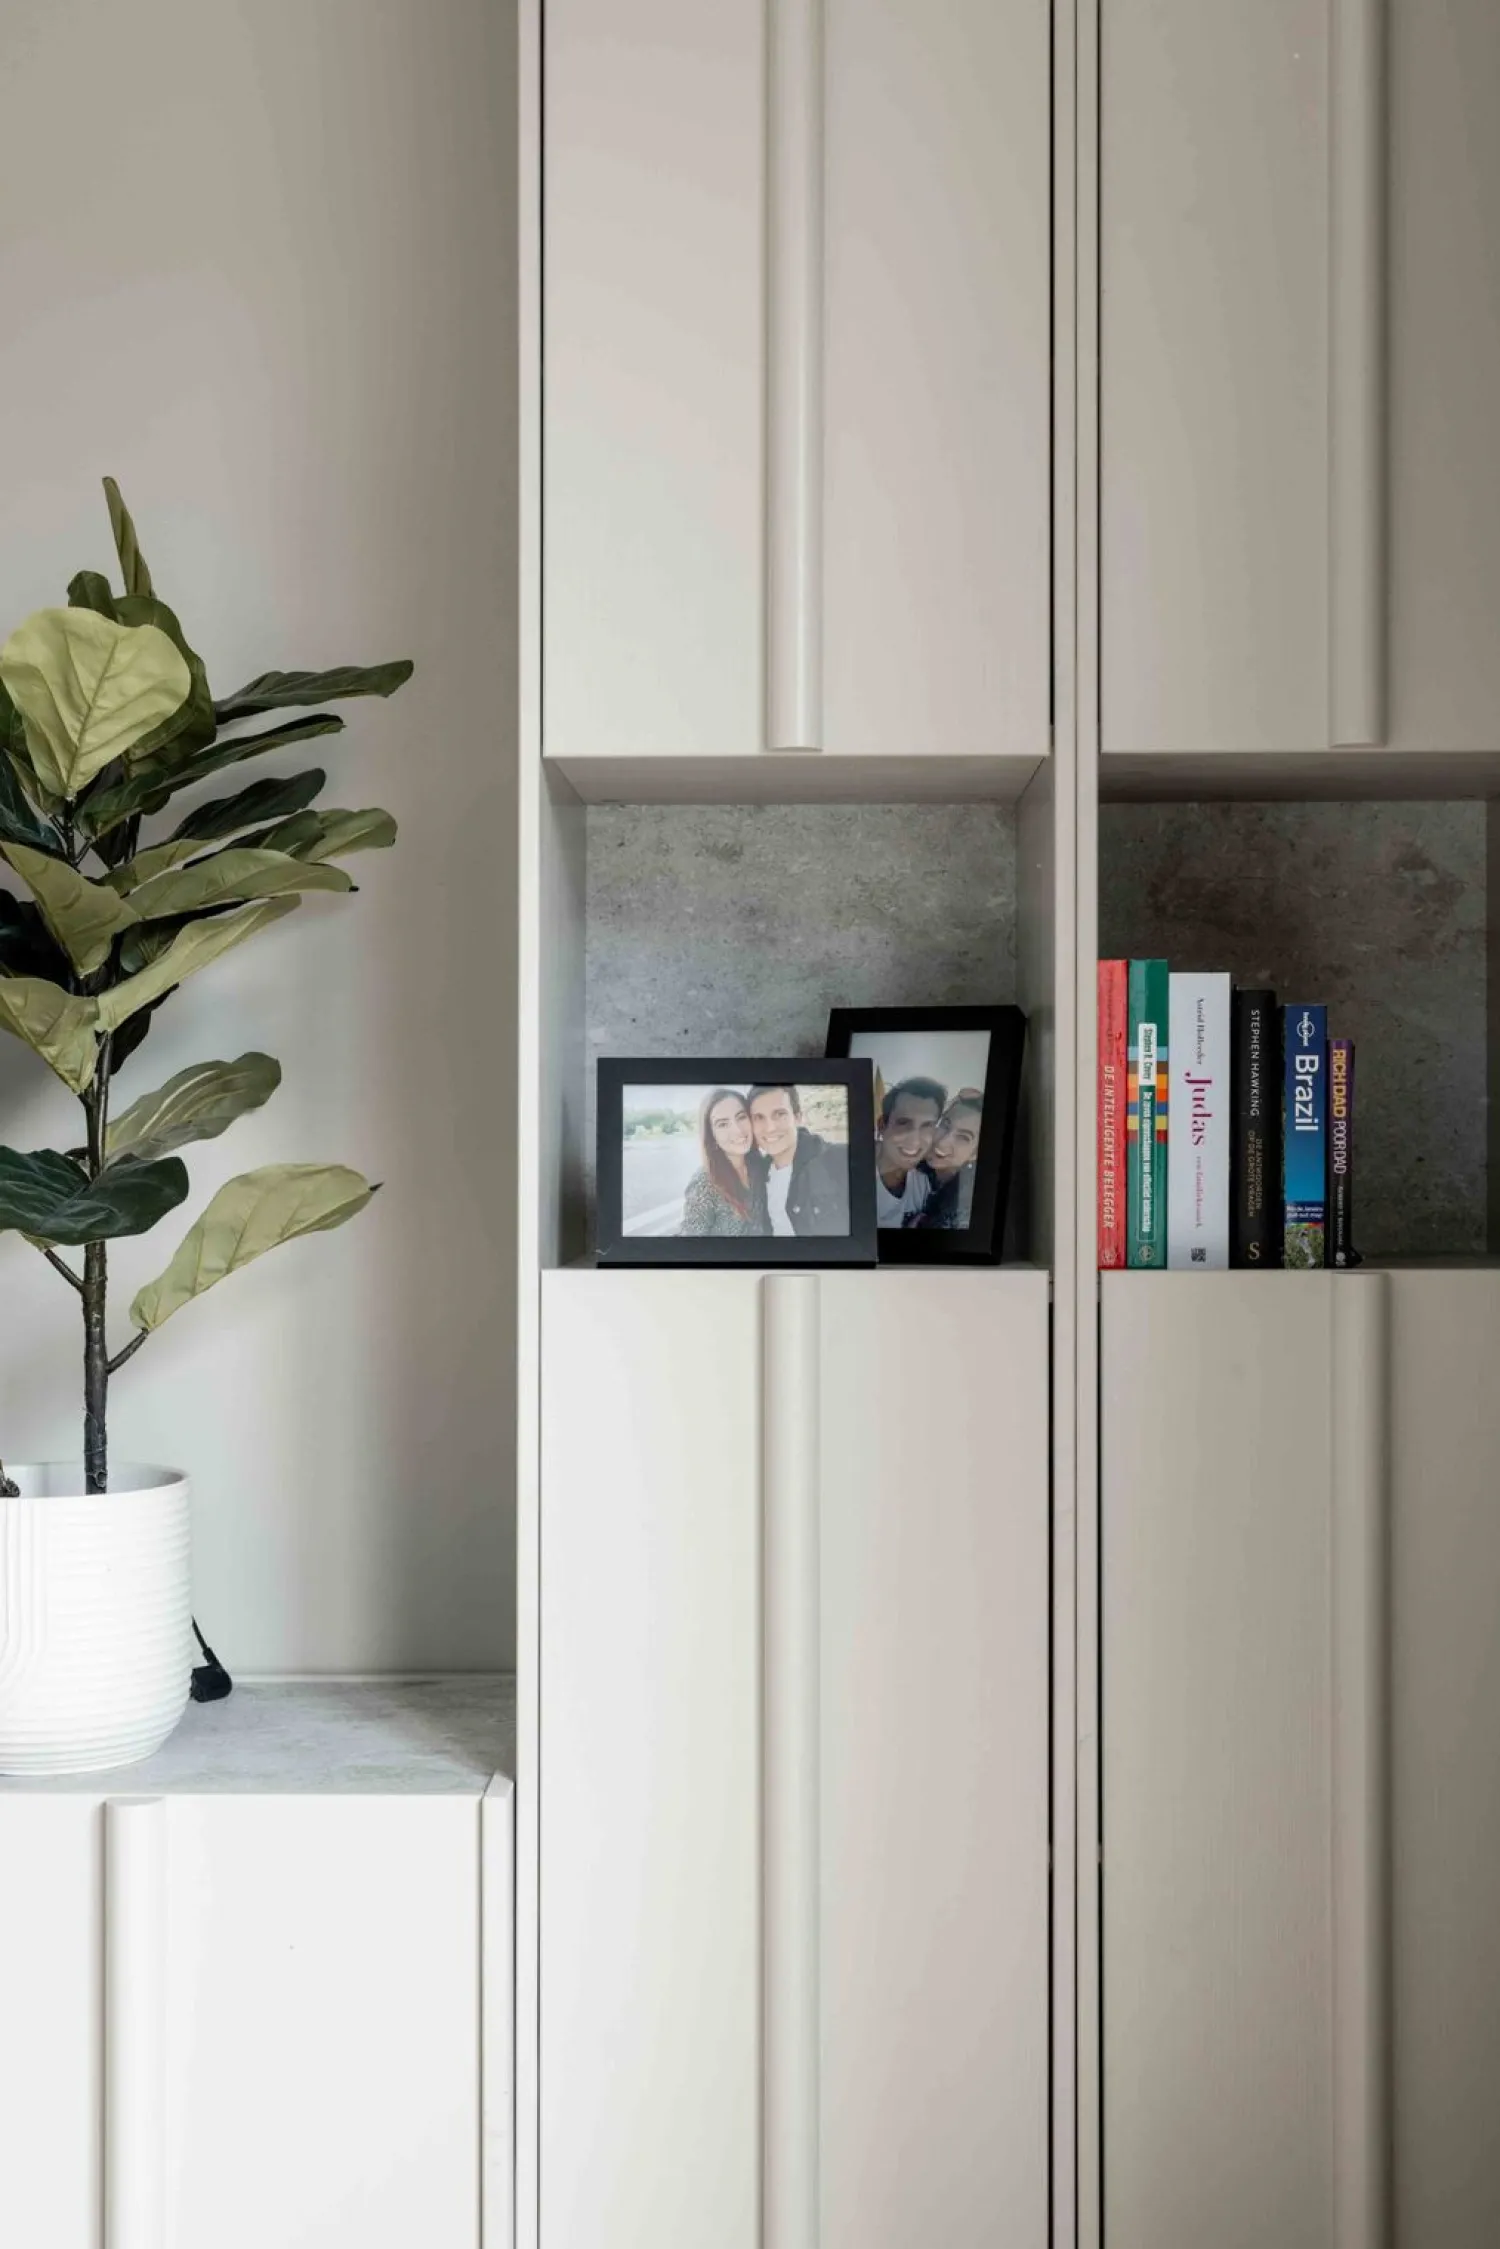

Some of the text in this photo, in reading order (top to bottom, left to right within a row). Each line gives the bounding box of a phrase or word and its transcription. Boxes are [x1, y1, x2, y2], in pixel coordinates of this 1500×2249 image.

[1104, 1065, 1115, 1081] DE
[1250, 1009, 1260, 1117] STEPHEN HAWKING
[1295, 1055, 1319, 1131] Brazil
[1103, 1084, 1115, 1166] INTELLIGENTE
[1185, 1071, 1213, 1147] Judas
[1332, 1049, 1347, 1174] RICH DAD POOR DAD
[1103, 1170, 1115, 1229] BELEGGER
